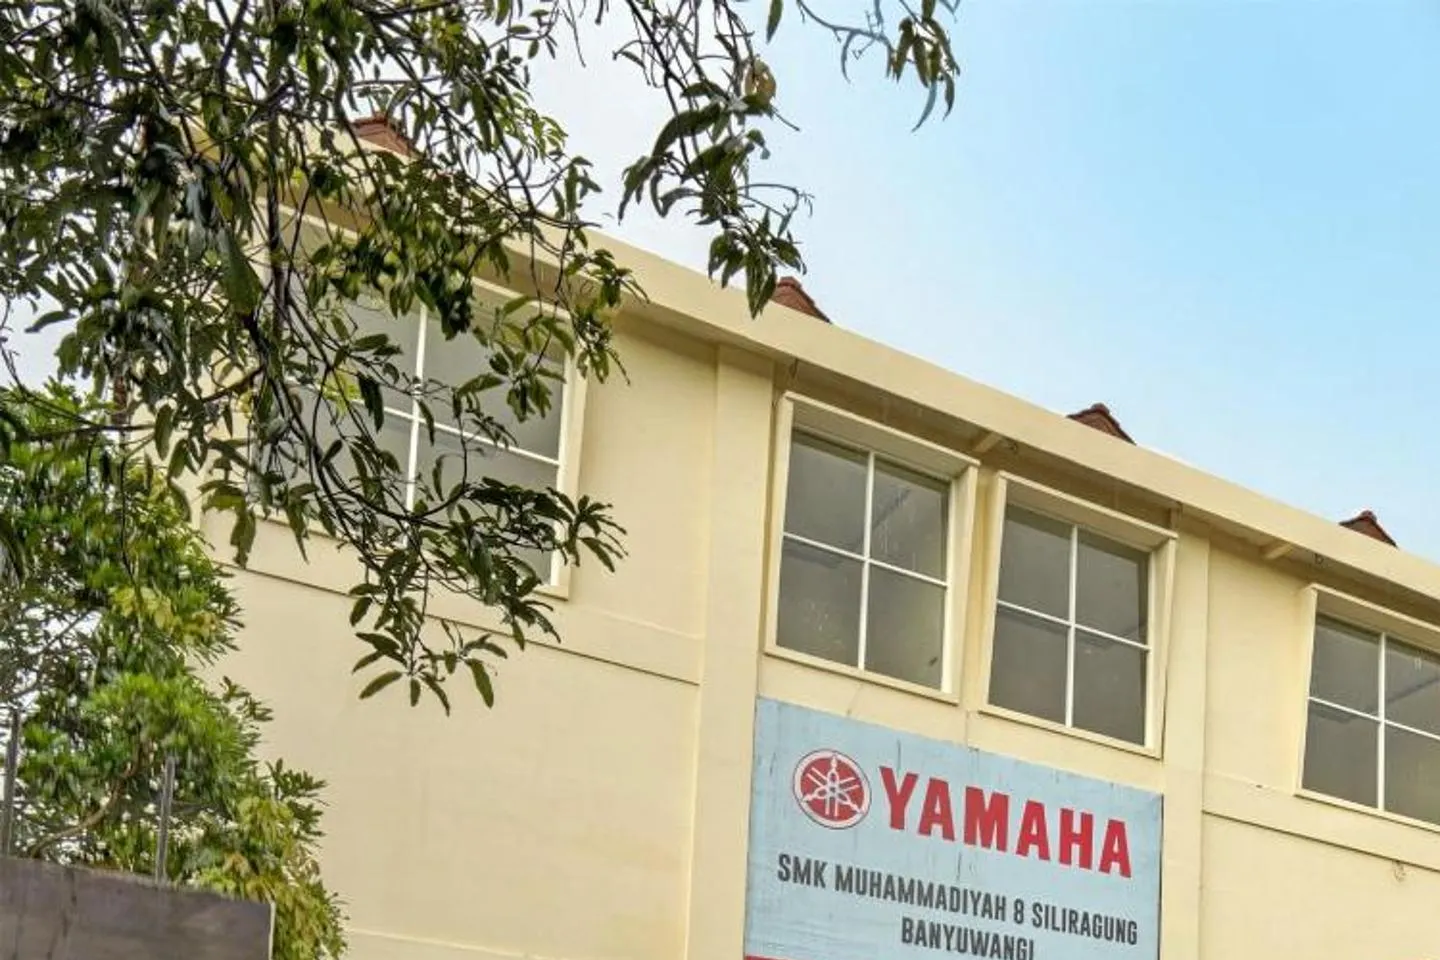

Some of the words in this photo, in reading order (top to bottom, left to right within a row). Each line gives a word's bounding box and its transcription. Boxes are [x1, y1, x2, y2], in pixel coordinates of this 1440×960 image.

[879, 766, 1132, 878] YAMAHA
[777, 853, 828, 889] SMK
[834, 864, 1006, 923] MUHAMMADIYAH
[1013, 898, 1025, 925] 8
[1032, 902, 1137, 946] SILIRAGUNG
